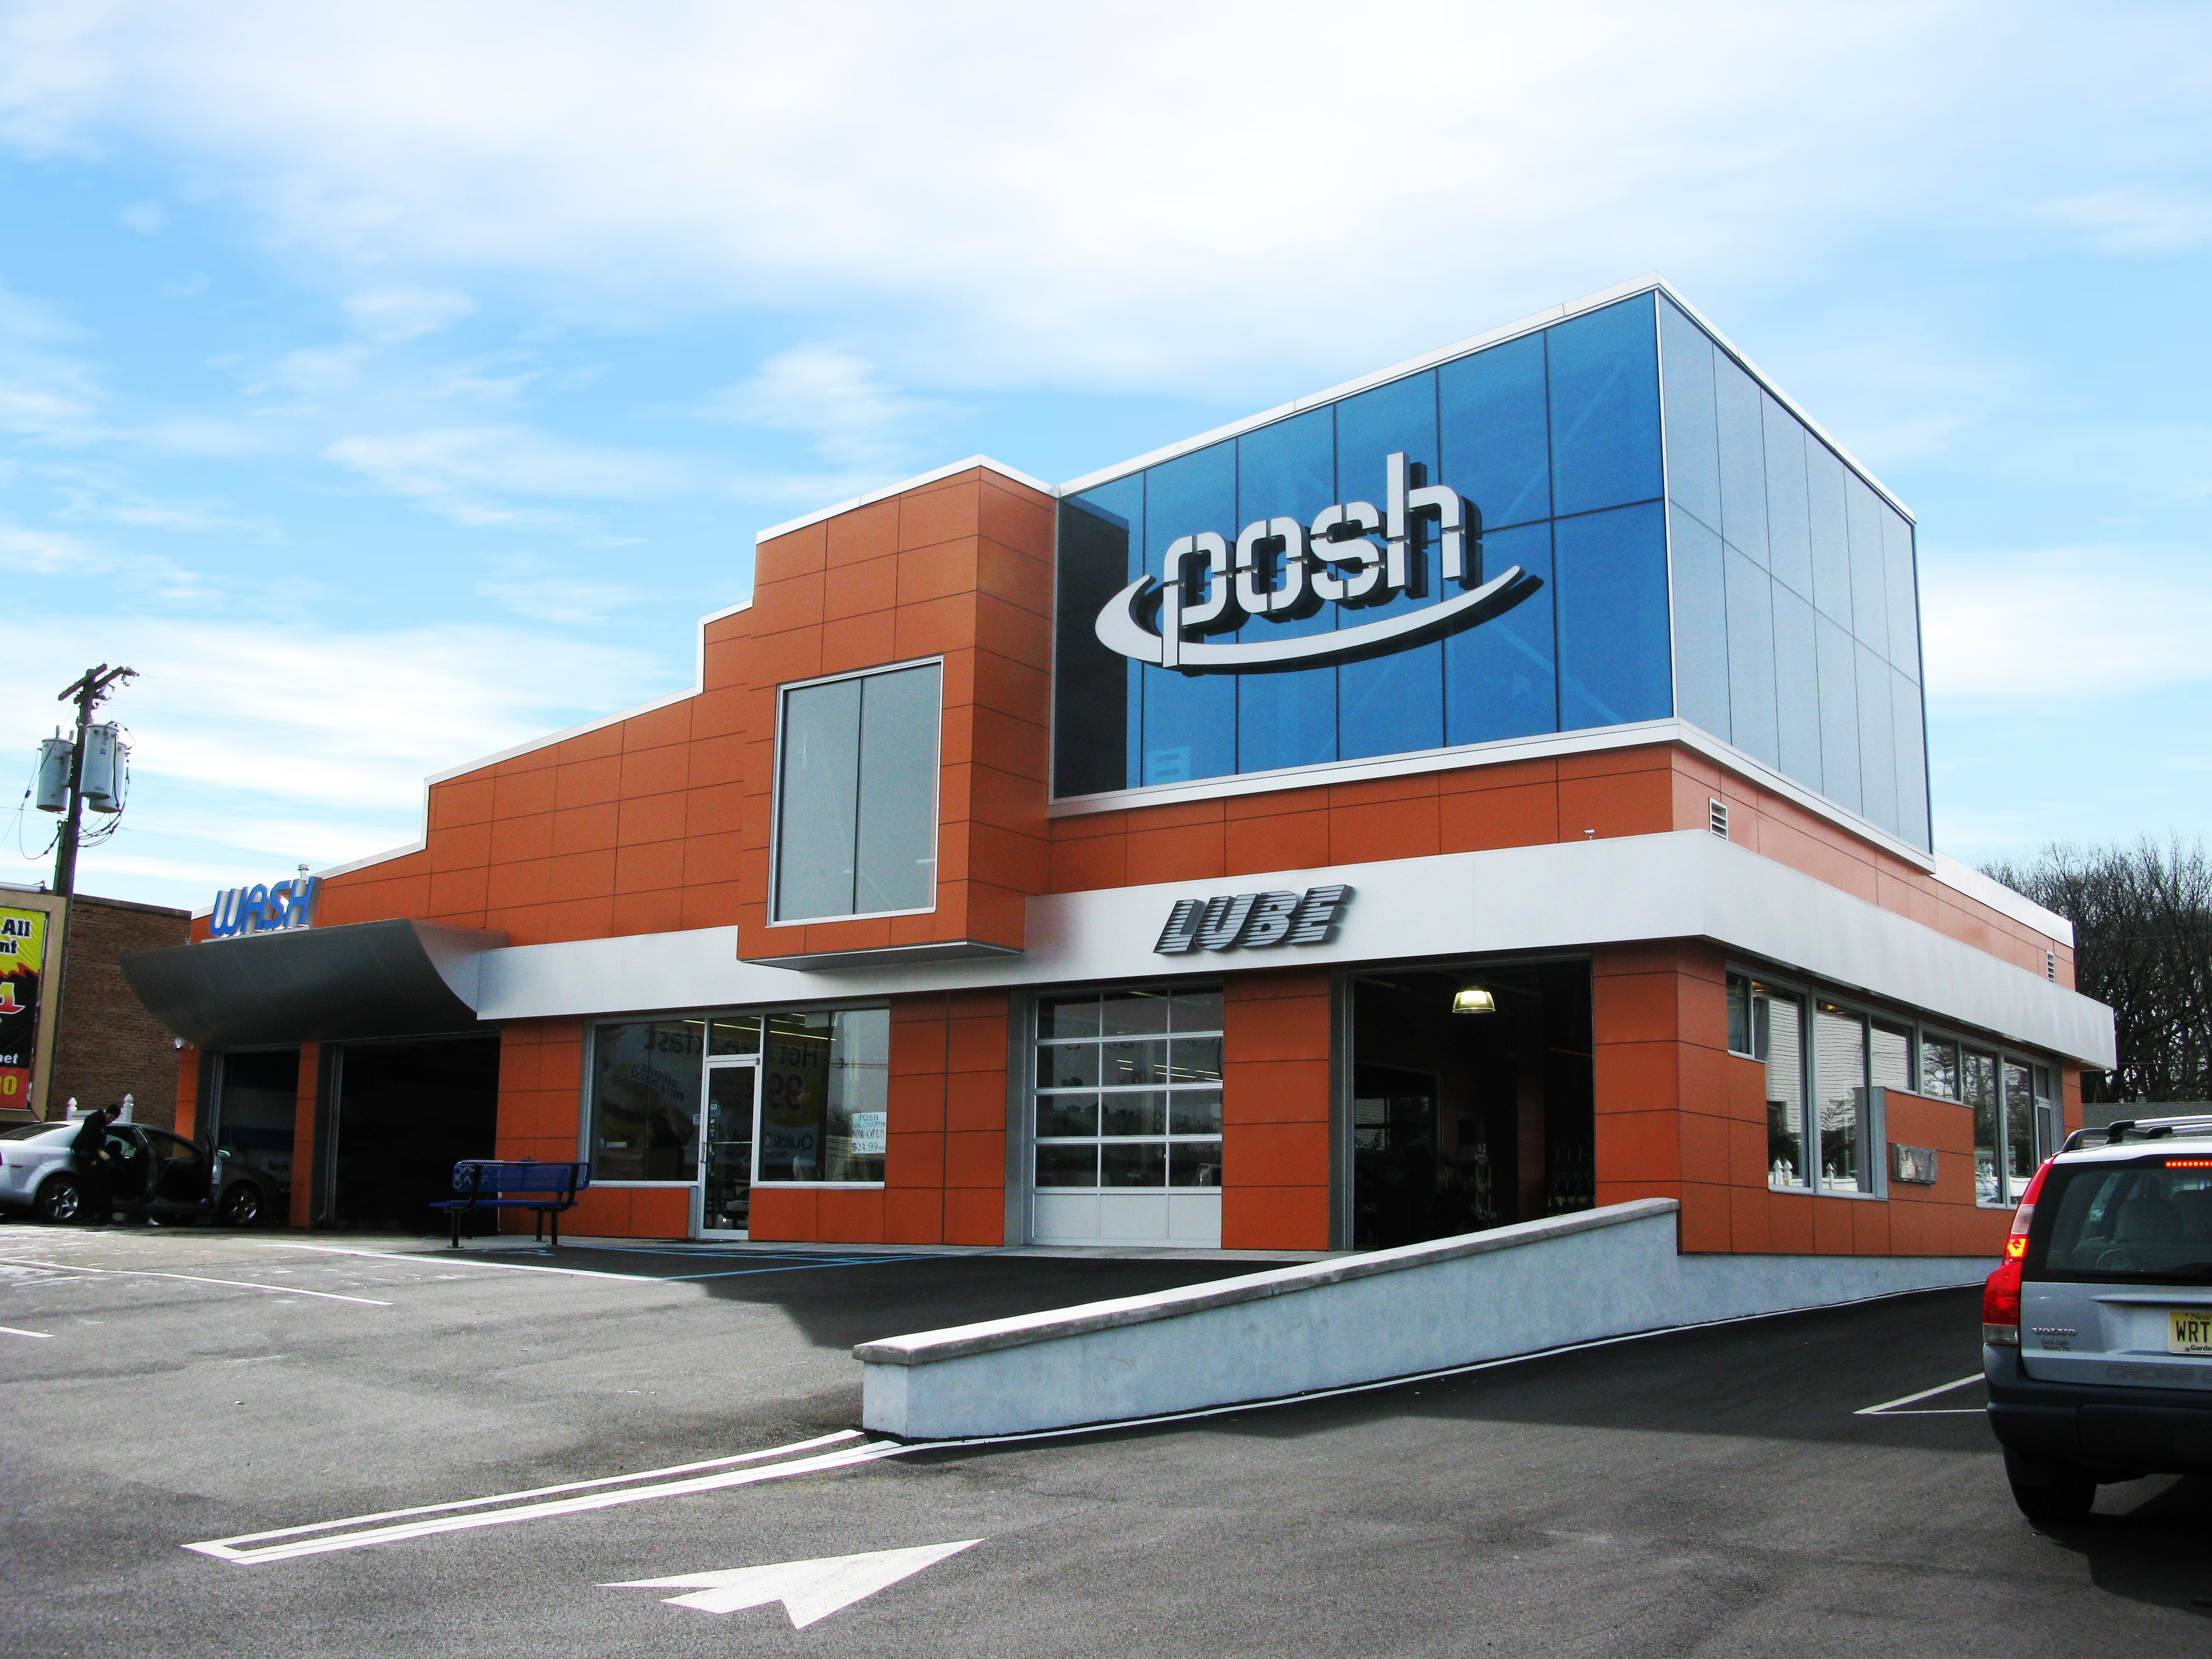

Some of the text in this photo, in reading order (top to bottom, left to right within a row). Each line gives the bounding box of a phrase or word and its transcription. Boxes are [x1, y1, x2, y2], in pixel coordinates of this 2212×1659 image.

[1163, 452, 1467, 667] posh
[210, 877, 322, 937] WASH
[2, 919, 30, 937] All
[1153, 884, 1354, 953] LUBE
[0, 1076, 17, 1095] 0
[852, 1129, 885, 1139] NOW OPEN
[2031, 1327, 2077, 1336] VOLVO
[2176, 1321, 2210, 1343] WRT
[2106, 1365, 2193, 1382] CROSS
